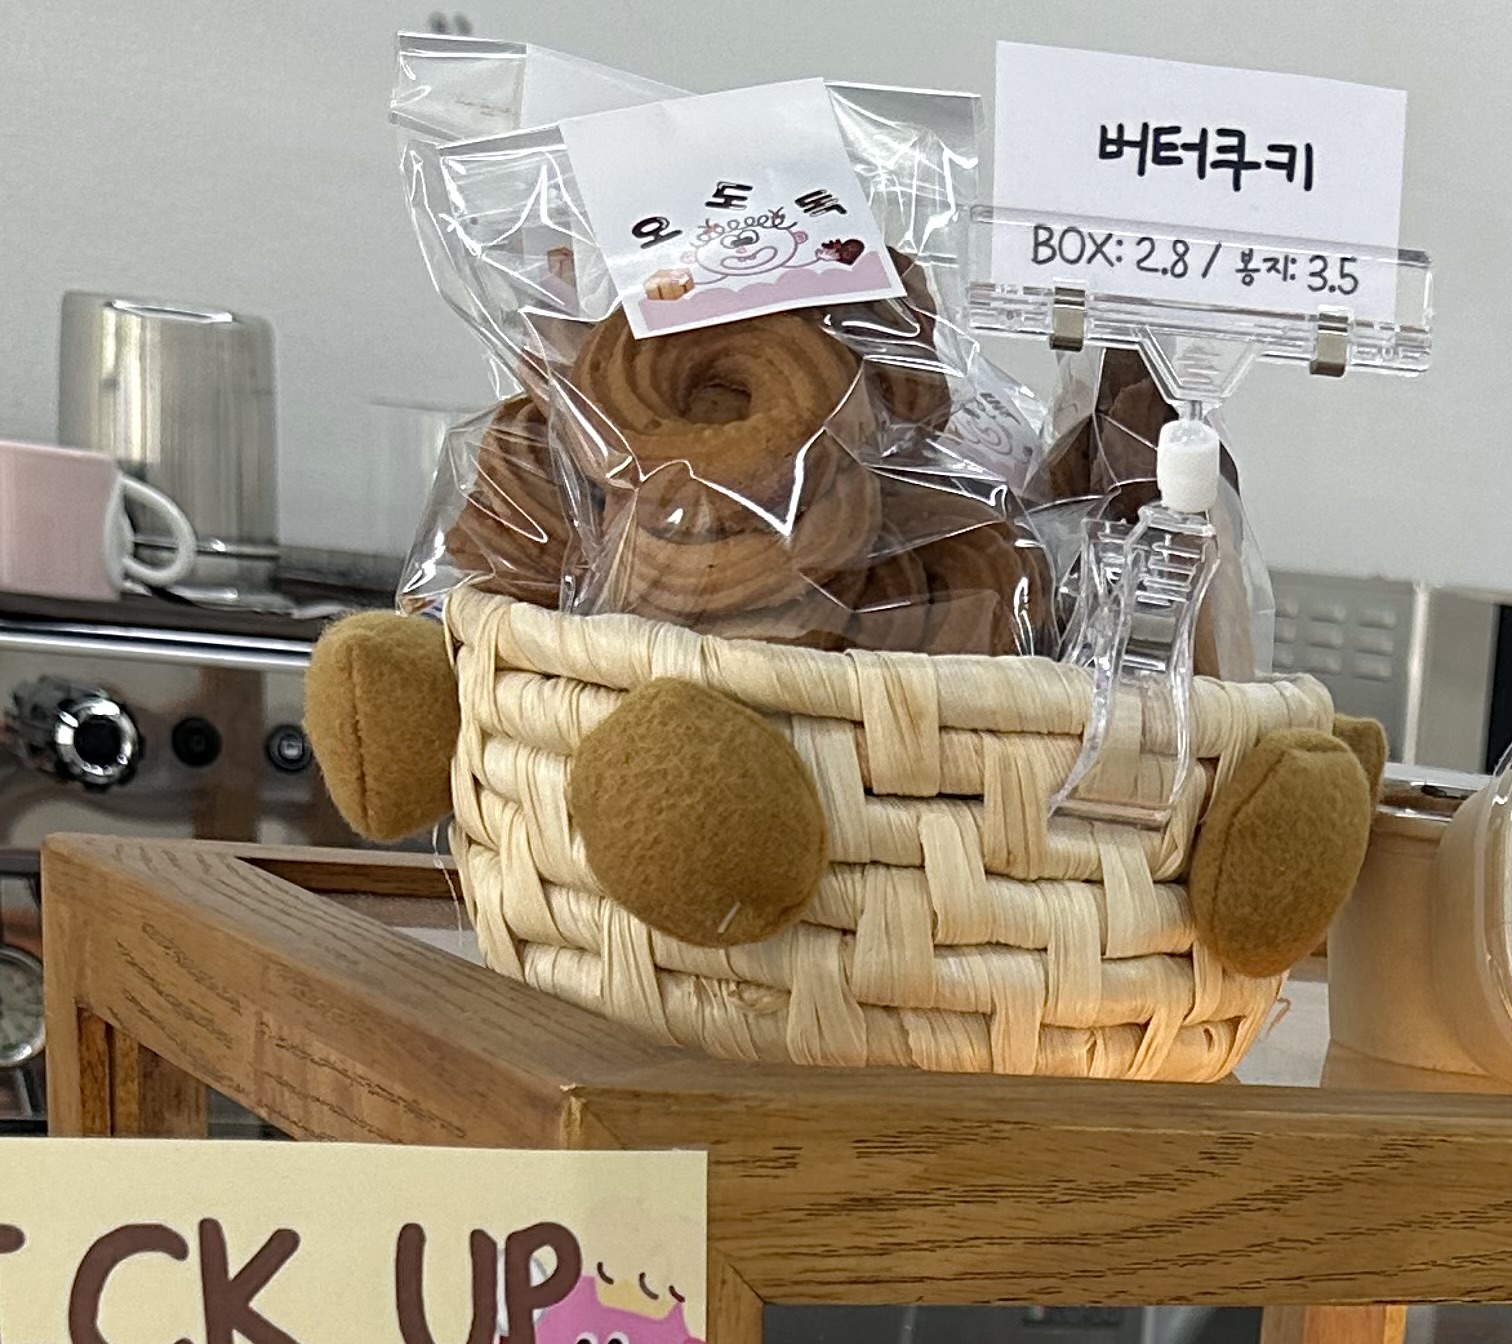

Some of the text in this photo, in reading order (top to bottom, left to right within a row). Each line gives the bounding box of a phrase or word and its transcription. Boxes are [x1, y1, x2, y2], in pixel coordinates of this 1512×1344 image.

[1098, 121, 1313, 192] 버터쿠키
[1031, 225, 1123, 270] BOX:
[1135, 236, 1190, 279] 2.8
[1235, 247, 1297, 287] 봉지:
[1306, 254, 1360, 296] 3.5
